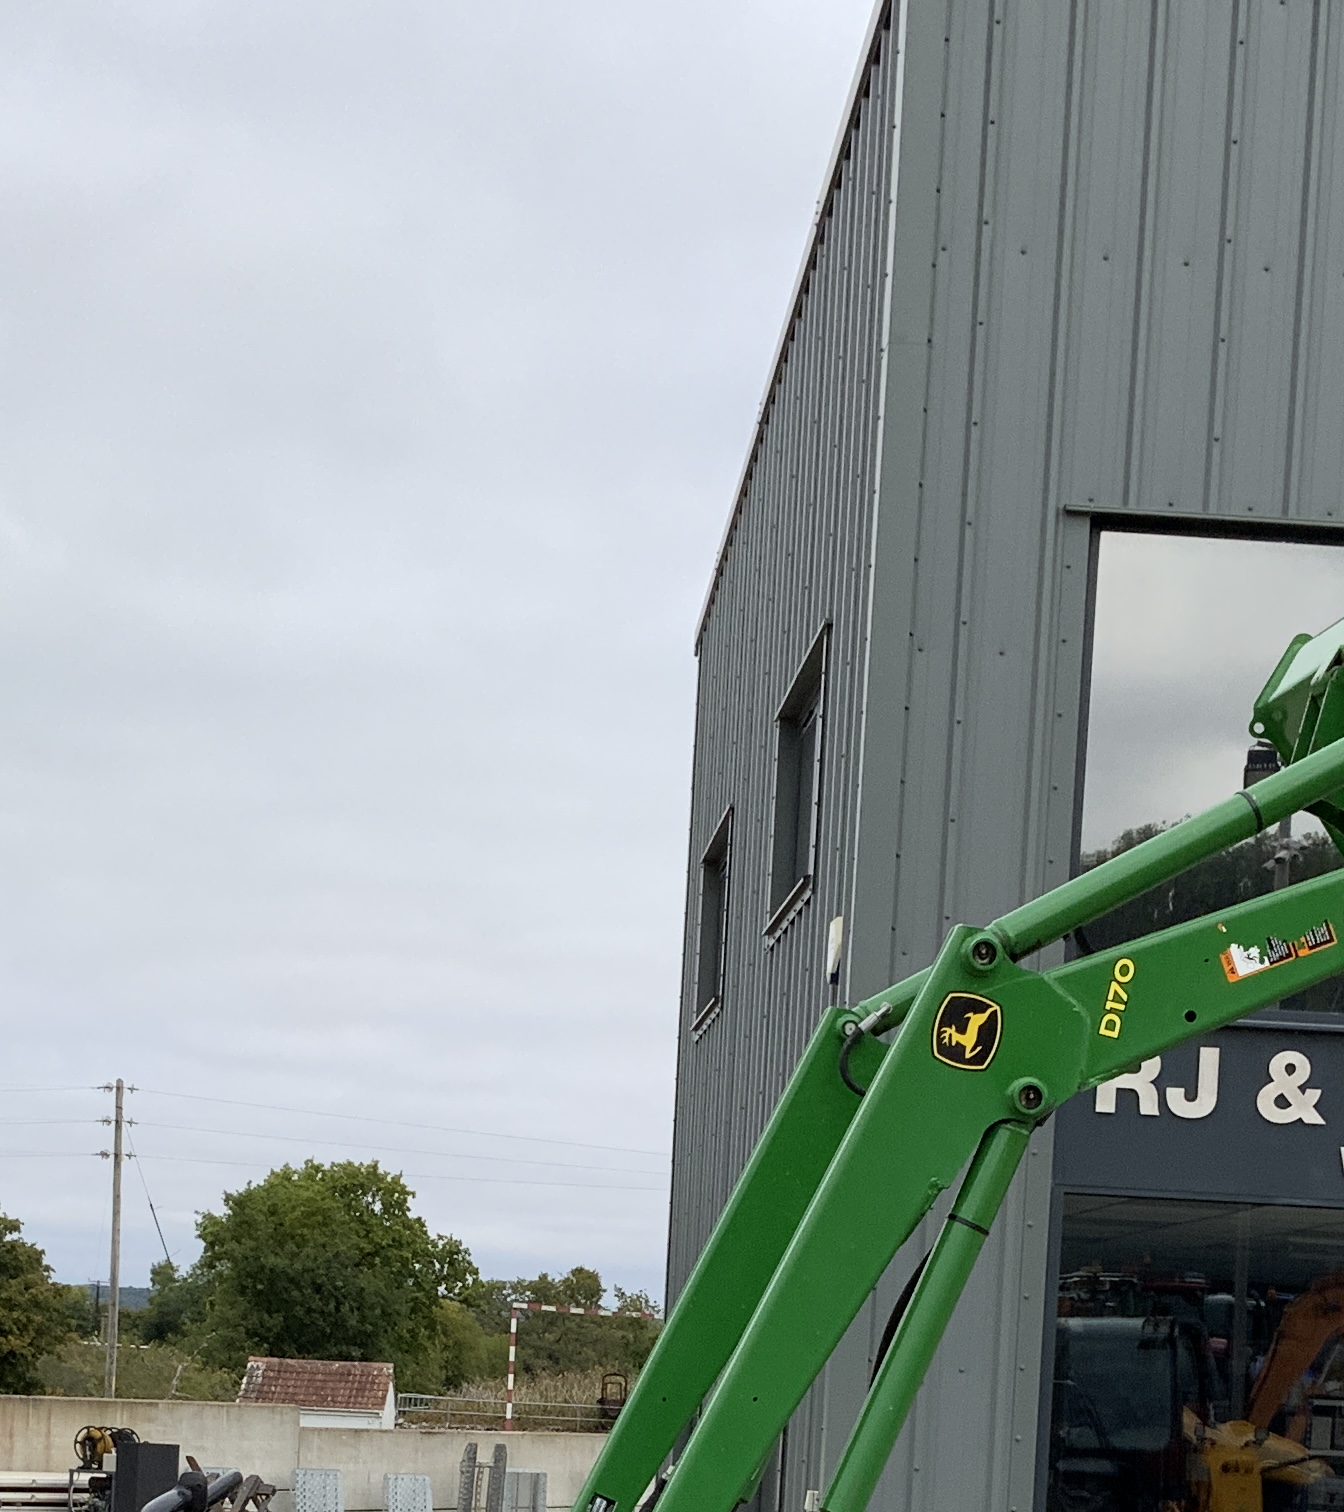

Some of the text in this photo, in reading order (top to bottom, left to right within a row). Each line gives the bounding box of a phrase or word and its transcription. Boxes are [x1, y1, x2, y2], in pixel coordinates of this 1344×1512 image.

[1098, 957, 1135, 1039] D170
[1094, 1046, 1221, 1119] RJ
[1256, 1050, 1327, 1125] &
